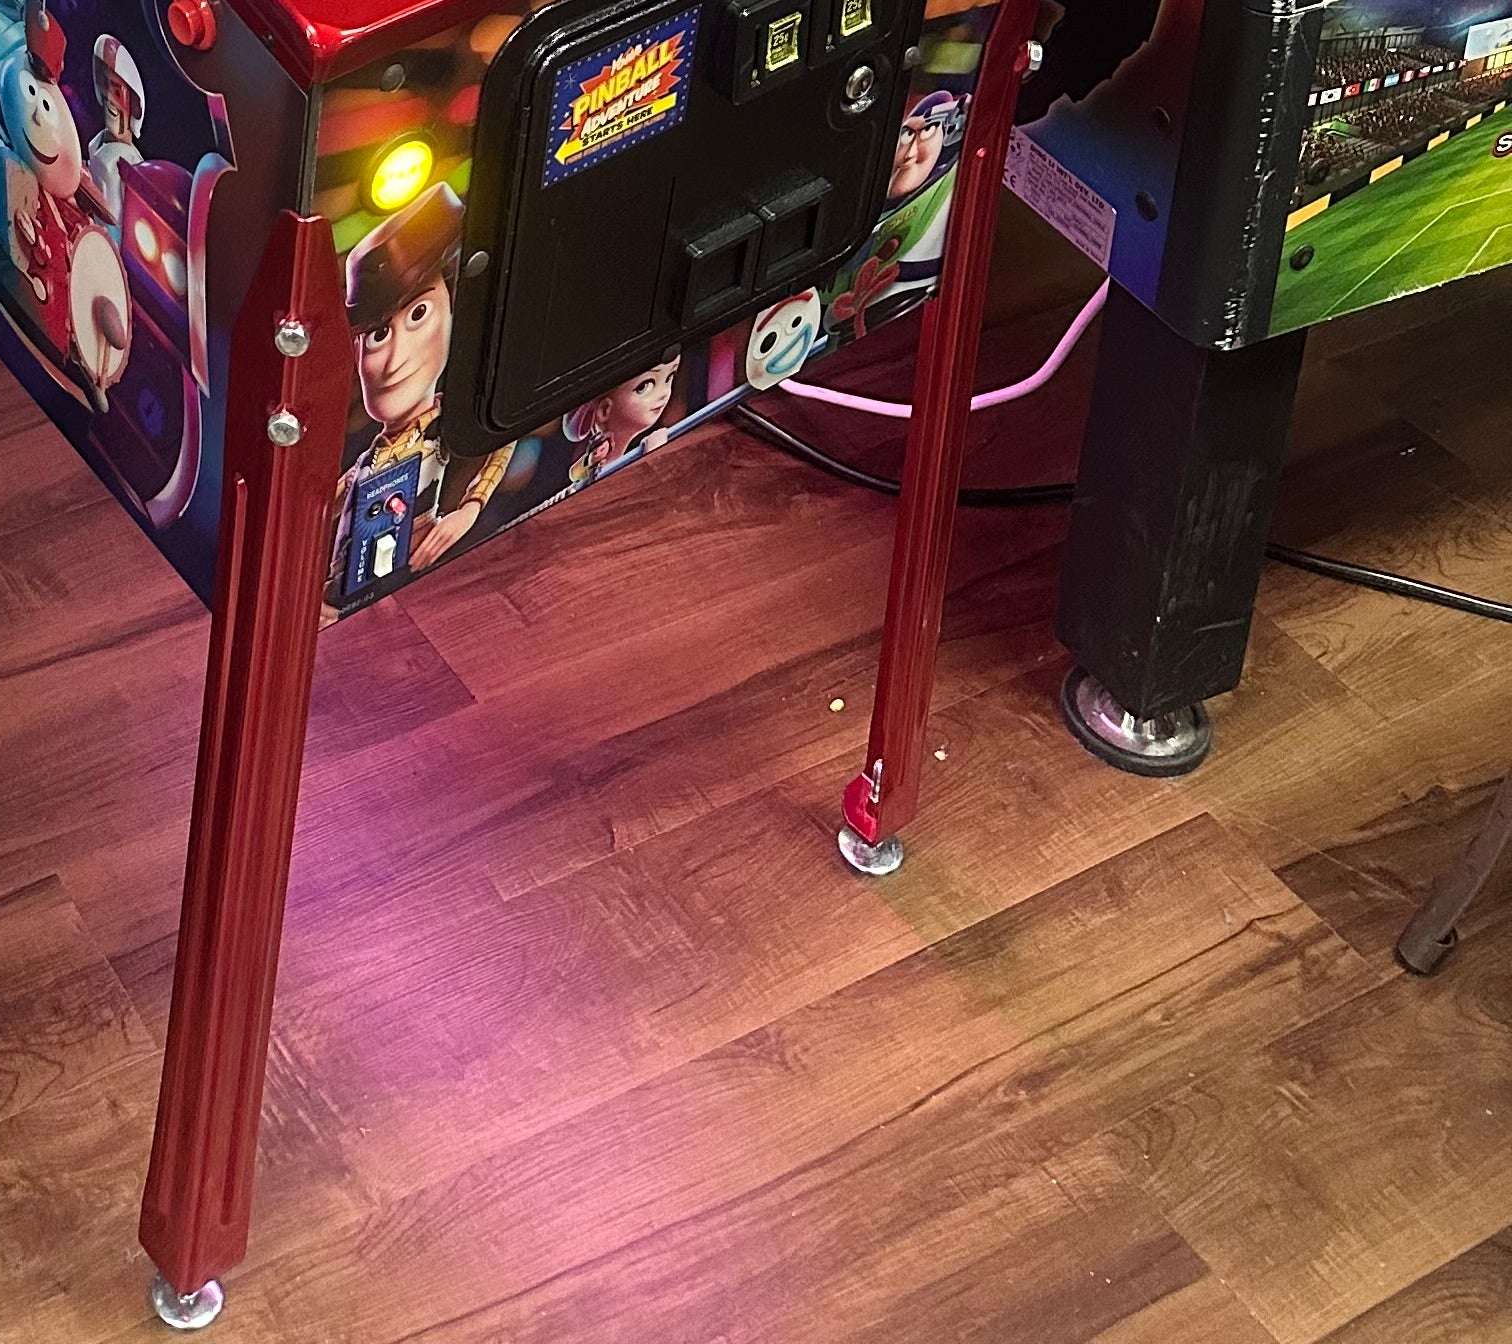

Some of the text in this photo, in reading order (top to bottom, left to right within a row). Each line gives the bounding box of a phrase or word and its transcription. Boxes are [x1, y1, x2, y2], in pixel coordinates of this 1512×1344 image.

[572, 40, 674, 127] PINBALL
[580, 72, 663, 140] ADVENTURE
[581, 105, 654, 148] STARTS HERE
